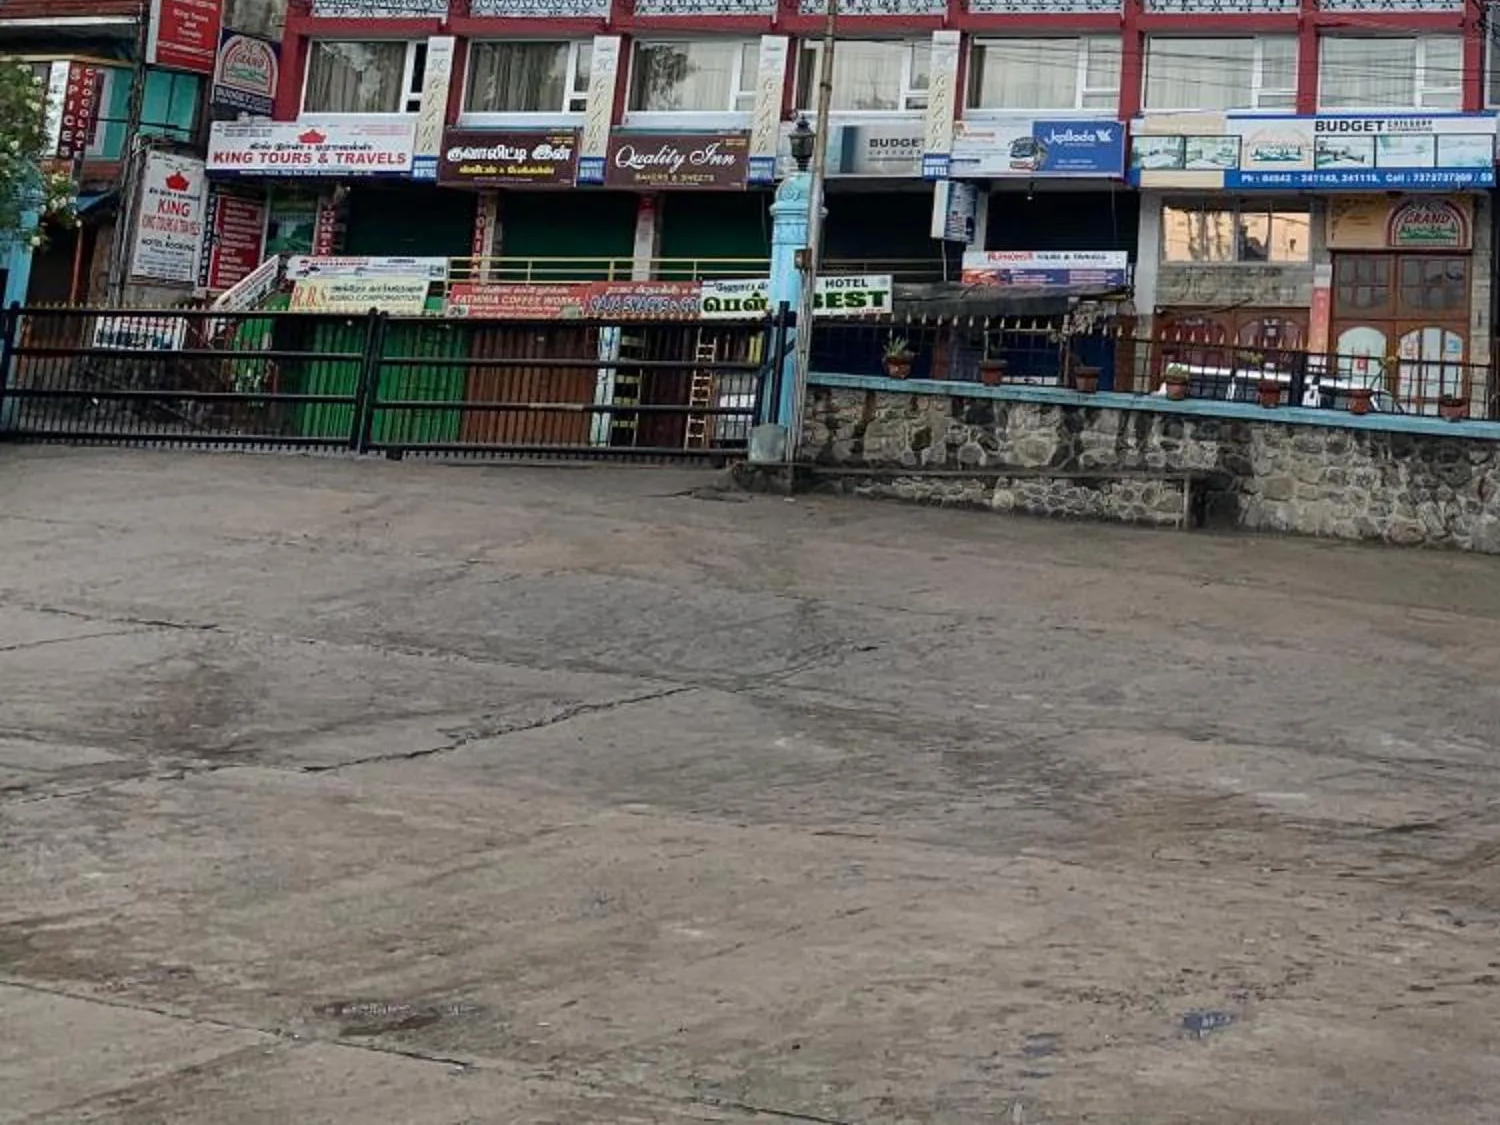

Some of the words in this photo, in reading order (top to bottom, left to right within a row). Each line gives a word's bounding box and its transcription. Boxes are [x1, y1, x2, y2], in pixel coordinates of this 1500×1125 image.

[1315, 120, 1384, 132] BUDGET
[213, 151, 253, 164] KING
[259, 151, 312, 164] TOURS
[318, 152, 329, 164] &
[336, 152, 407, 164] TRAVELS
[615, 143, 686, 173] Quality
[689, 142, 736, 166] Inn
[157, 198, 191, 217] KING
[1405, 213, 1450, 224] GRAND
[825, 278, 868, 288] HOTEL
[501, 295, 542, 306] COFFEE
